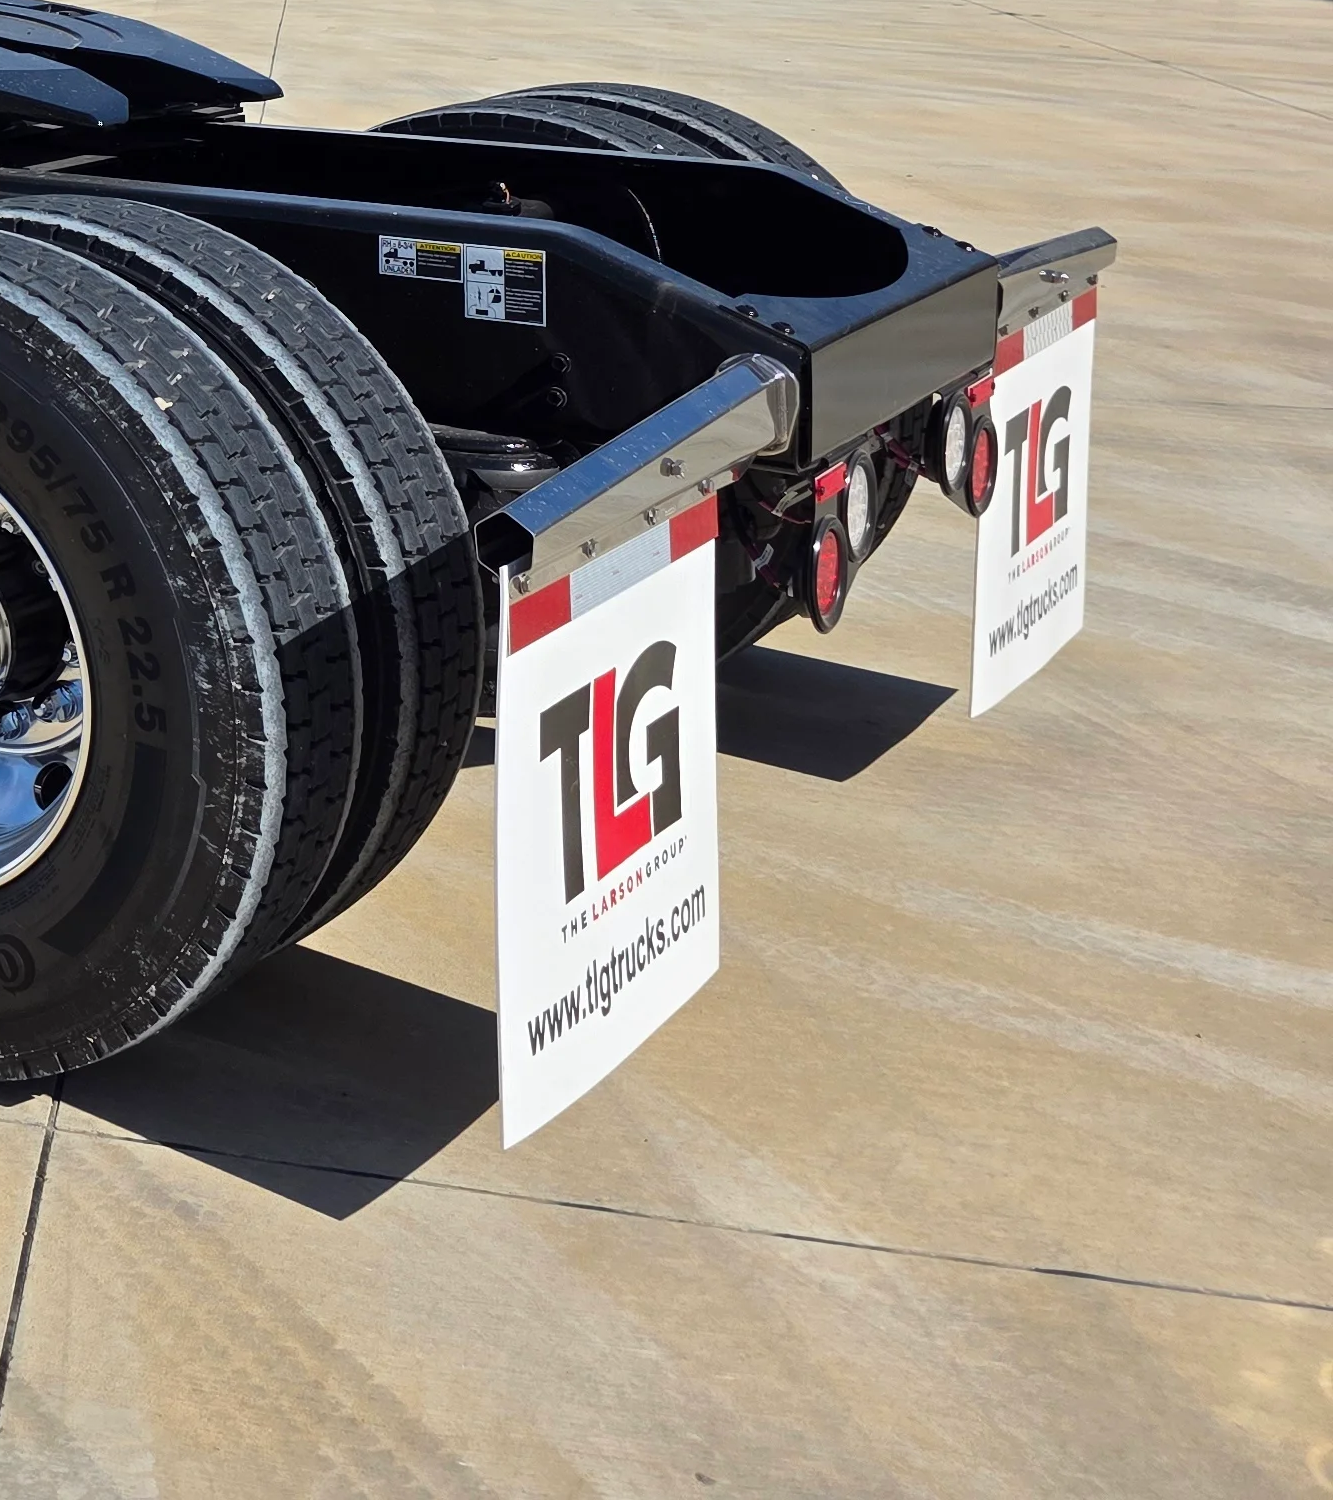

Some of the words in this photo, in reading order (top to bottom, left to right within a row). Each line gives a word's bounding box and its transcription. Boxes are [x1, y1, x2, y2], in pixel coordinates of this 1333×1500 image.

[419, 243, 456, 252] ATTENTION
[511, 251, 542, 260] CAUTION
[1004, 384, 1071, 558] TLG
[99, 561, 137, 603] R
[989, 563, 1078, 658] www.tlgtrucks.com
[116, 614, 168, 734] 22.5
[539, 639, 683, 905] TLG
[527, 883, 707, 1057] www.tlgtrucks.com
[561, 909, 588, 944] THE
